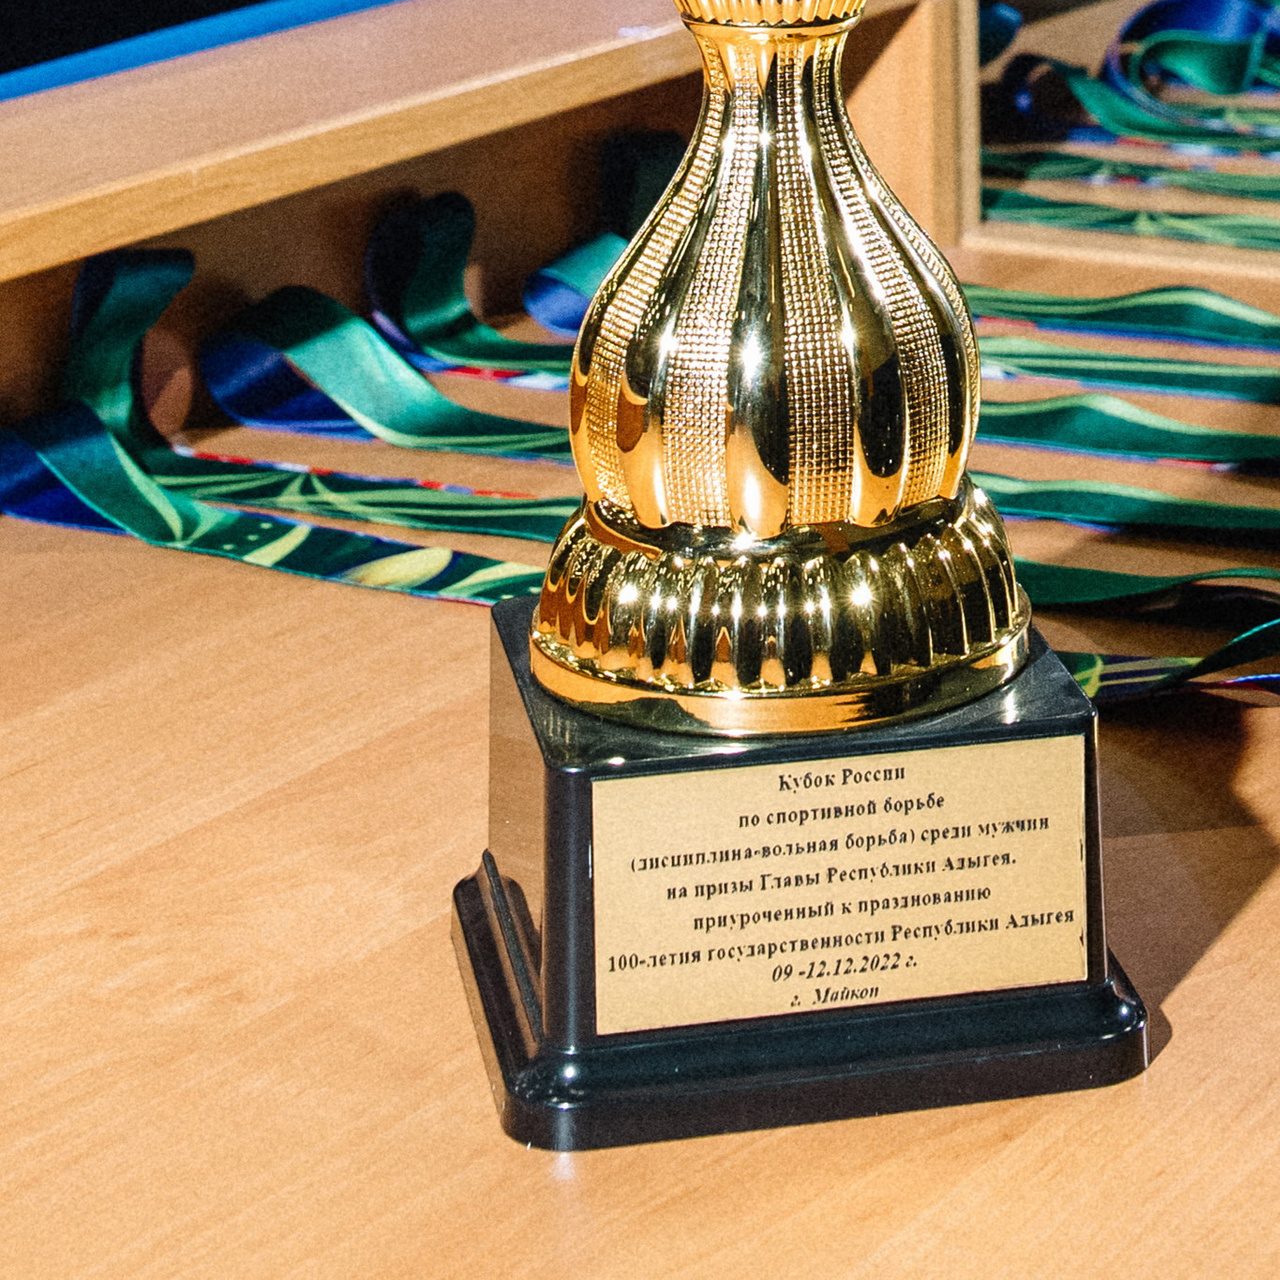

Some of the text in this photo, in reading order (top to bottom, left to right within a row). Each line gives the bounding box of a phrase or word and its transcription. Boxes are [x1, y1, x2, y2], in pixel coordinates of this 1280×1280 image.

[778, 767, 905, 794] Кубок России
[739, 792, 945, 828] по спортивной борьбе
[845, 828, 915, 852] борьба)
[920, 824, 971, 845] среди
[978, 817, 1049, 838] мужчин
[667, 852, 1017, 900] на призы Главы Республики Адыгея.
[693, 887, 991, 933] приуроченный к празднованию
[608, 909, 1075, 972] 100-летия государственности Республики Адыгея
[772, 964, 793, 982] 09
[812, 986, 879, 1006] Майкоп
